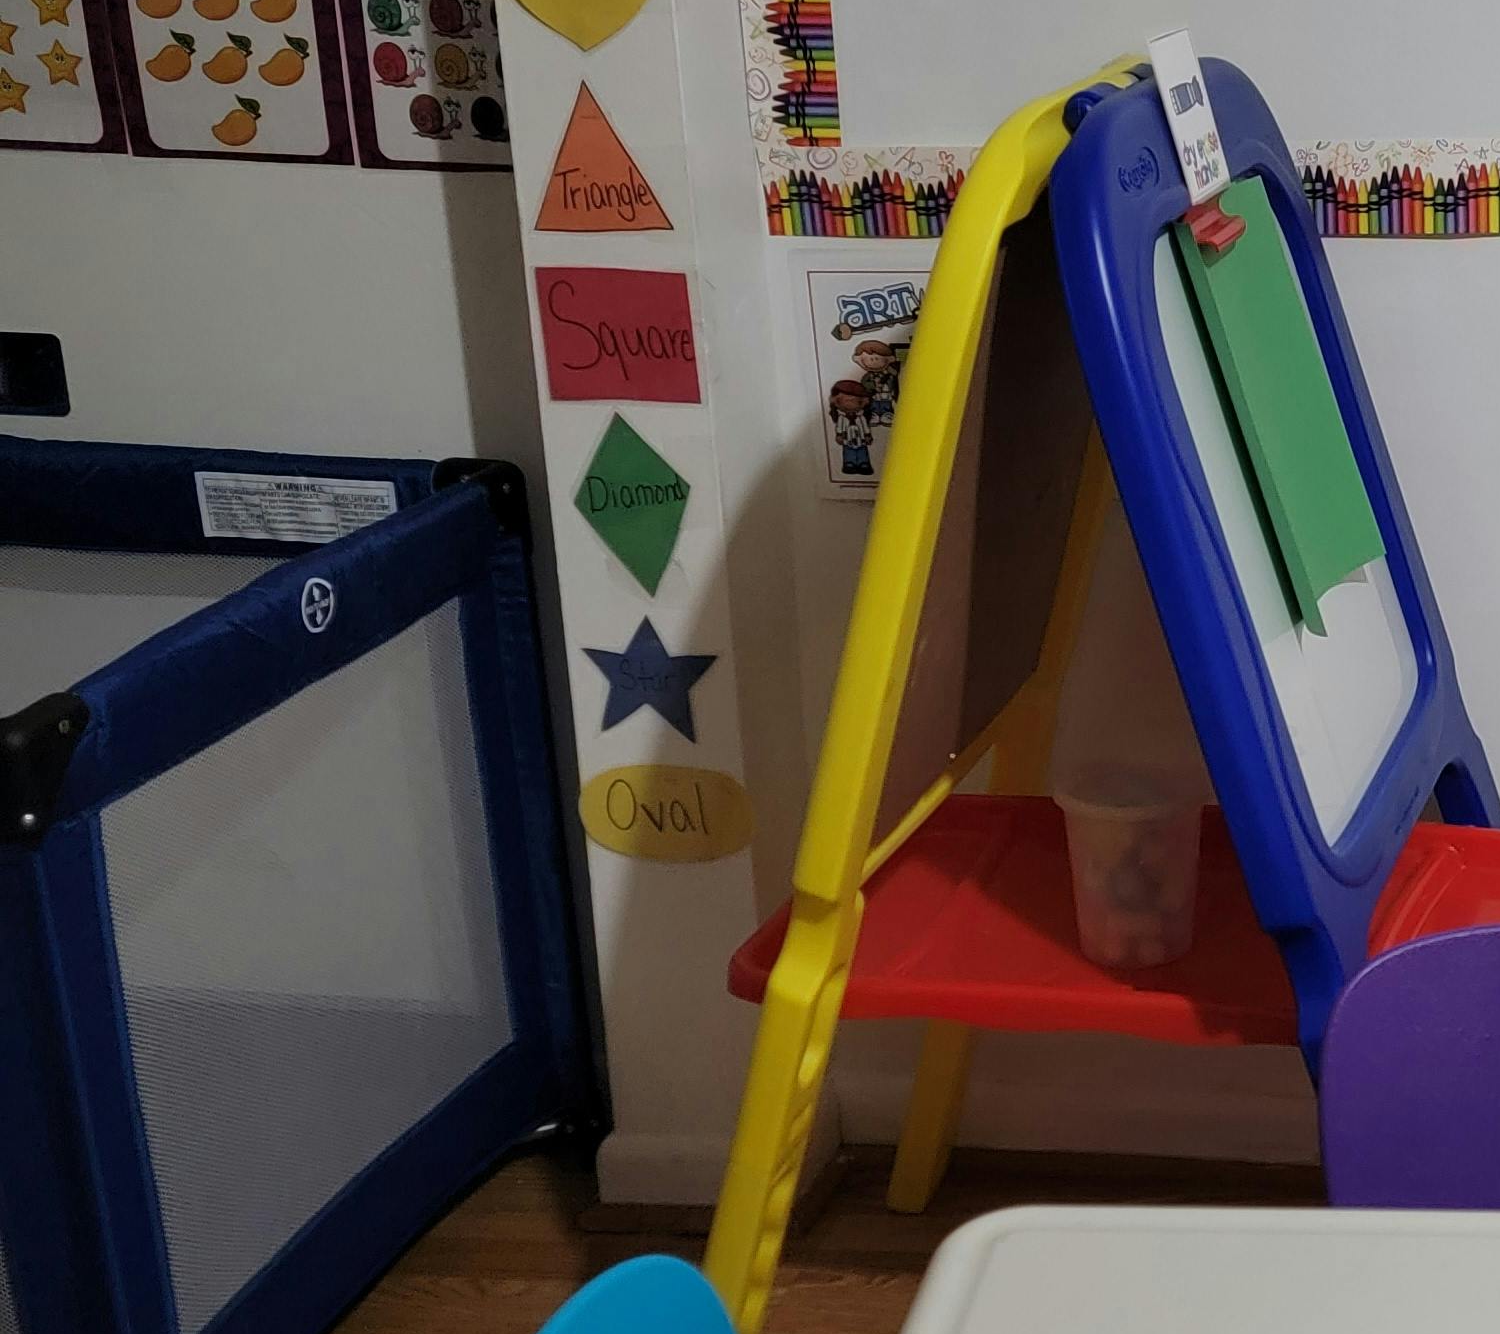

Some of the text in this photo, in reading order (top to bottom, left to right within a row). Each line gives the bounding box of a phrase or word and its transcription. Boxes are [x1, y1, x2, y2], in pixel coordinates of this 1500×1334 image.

[555, 167, 653, 220] Triangle
[548, 280, 695, 380] Square
[584, 473, 687, 513] Diamond
[614, 658, 678, 692] Star
[606, 779, 710, 836] Oval
